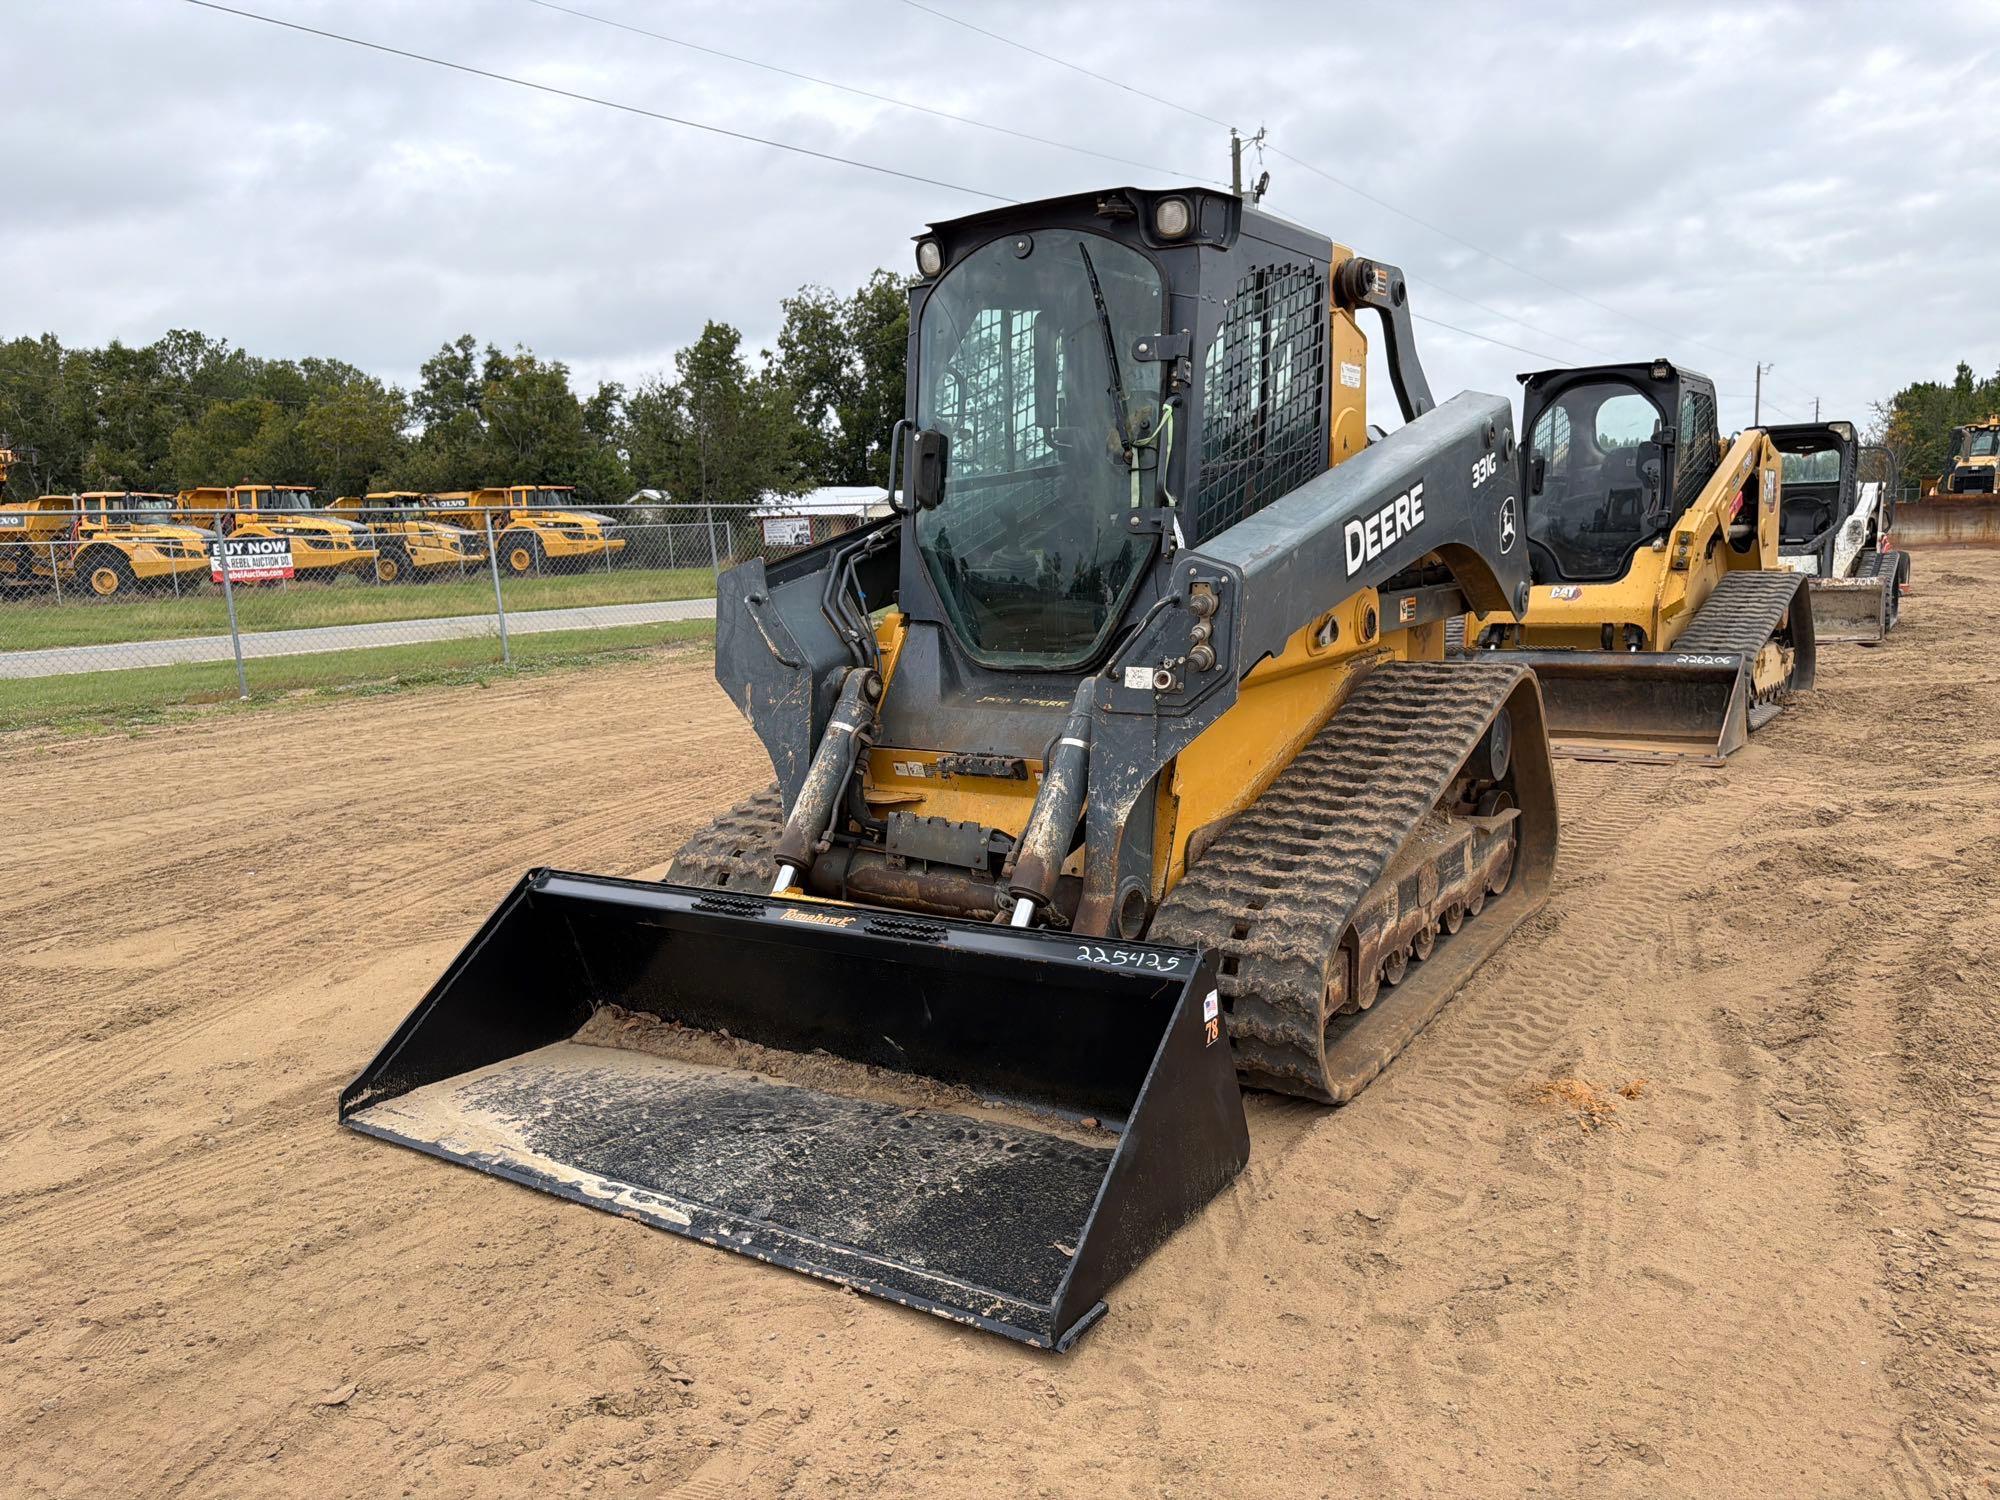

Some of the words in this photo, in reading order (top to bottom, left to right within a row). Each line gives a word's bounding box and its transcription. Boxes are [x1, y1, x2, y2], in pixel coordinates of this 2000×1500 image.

[1472, 452, 1497, 489] 331G
[1344, 482, 1425, 577] DEERE
[212, 542, 243, 556] BUY
[247, 541, 286, 556] NOW
[231, 557, 251, 569] REBEL
[252, 556, 279, 568] AUCTION
[1550, 585, 1576, 600] CAT
[1676, 653, 1732, 665] 226206
[780, 908, 856, 927] Tomahawk
[1077, 945, 1181, 972] 225425
[1205, 1017, 1219, 1044] 78
